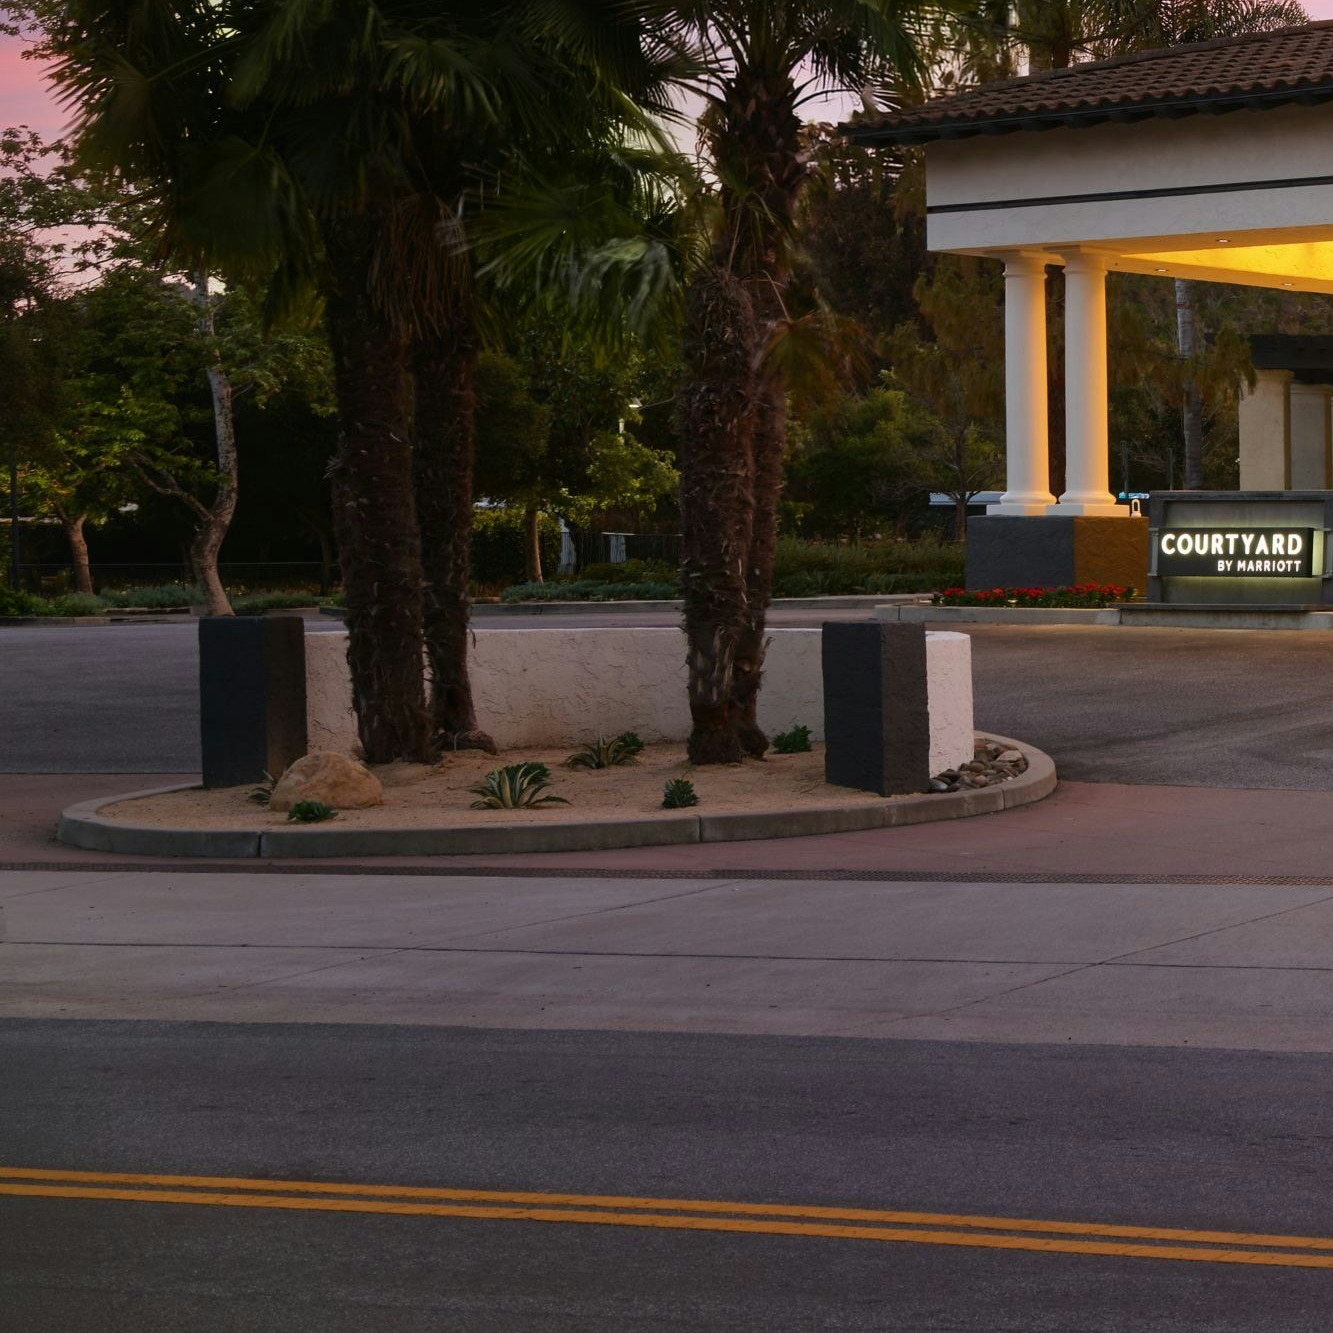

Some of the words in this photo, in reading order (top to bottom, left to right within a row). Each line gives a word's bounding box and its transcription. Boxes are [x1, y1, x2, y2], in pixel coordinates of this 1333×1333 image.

[1161, 533, 1303, 555] COURTYARD
[1217, 560, 1233, 572] BY
[1236, 560, 1302, 573] MARRIOTT
